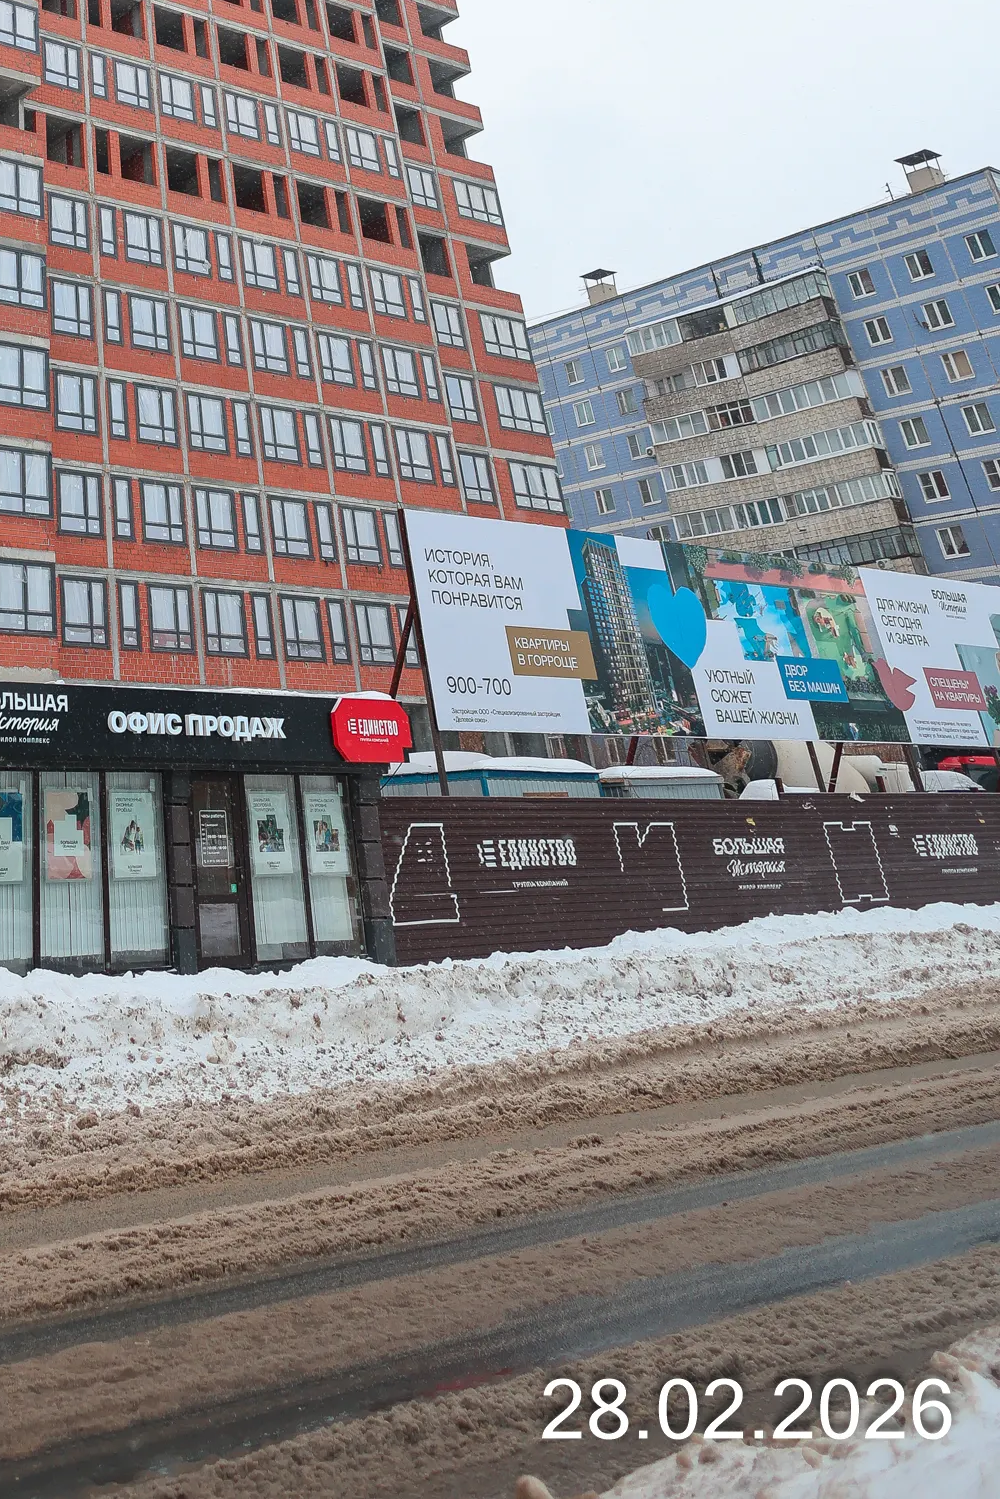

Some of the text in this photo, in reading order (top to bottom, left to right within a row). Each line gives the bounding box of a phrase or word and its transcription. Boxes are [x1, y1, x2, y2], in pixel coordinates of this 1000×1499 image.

[424, 548, 494, 570] ИСТОРИЯ,
[428, 569, 524, 591] КОТОРАЯ ВАМ
[431, 590, 524, 611] ПОНРАВИТСЯ
[931, 589, 967, 604] БОЛЬШАЯ
[876, 597, 930, 615] ДЛЯ ЖИЗНИ
[938, 601, 967, 615] История
[881, 614, 923, 631] СЕГОДНЯ
[514, 637, 570, 652] КВАРТИРЫ
[886, 631, 930, 647] И ЗАВТРА
[517, 654, 525, 666] В
[704, 668, 756, 685] УЮТНЫЙ
[784, 664, 809, 678] ДВОР
[446, 676, 512, 696] 900-700
[788, 680, 842, 695] БЕЗ МАШИН
[710, 689, 753, 704] СЮЖЕТ
[933, 690, 982, 704] НА КВАРТИРЫ
[715, 707, 800, 726] ВАШЕЙ ЖИЗНИ
[107, 710, 287, 742] ОФИС ПРОДАЖ
[358, 718, 399, 737] ЕДИНСТВО
[498, 839, 577, 870] ЕДИНСТВО
[712, 837, 785, 855] БОЛЬШАЯ
[726, 859, 786, 879] История
